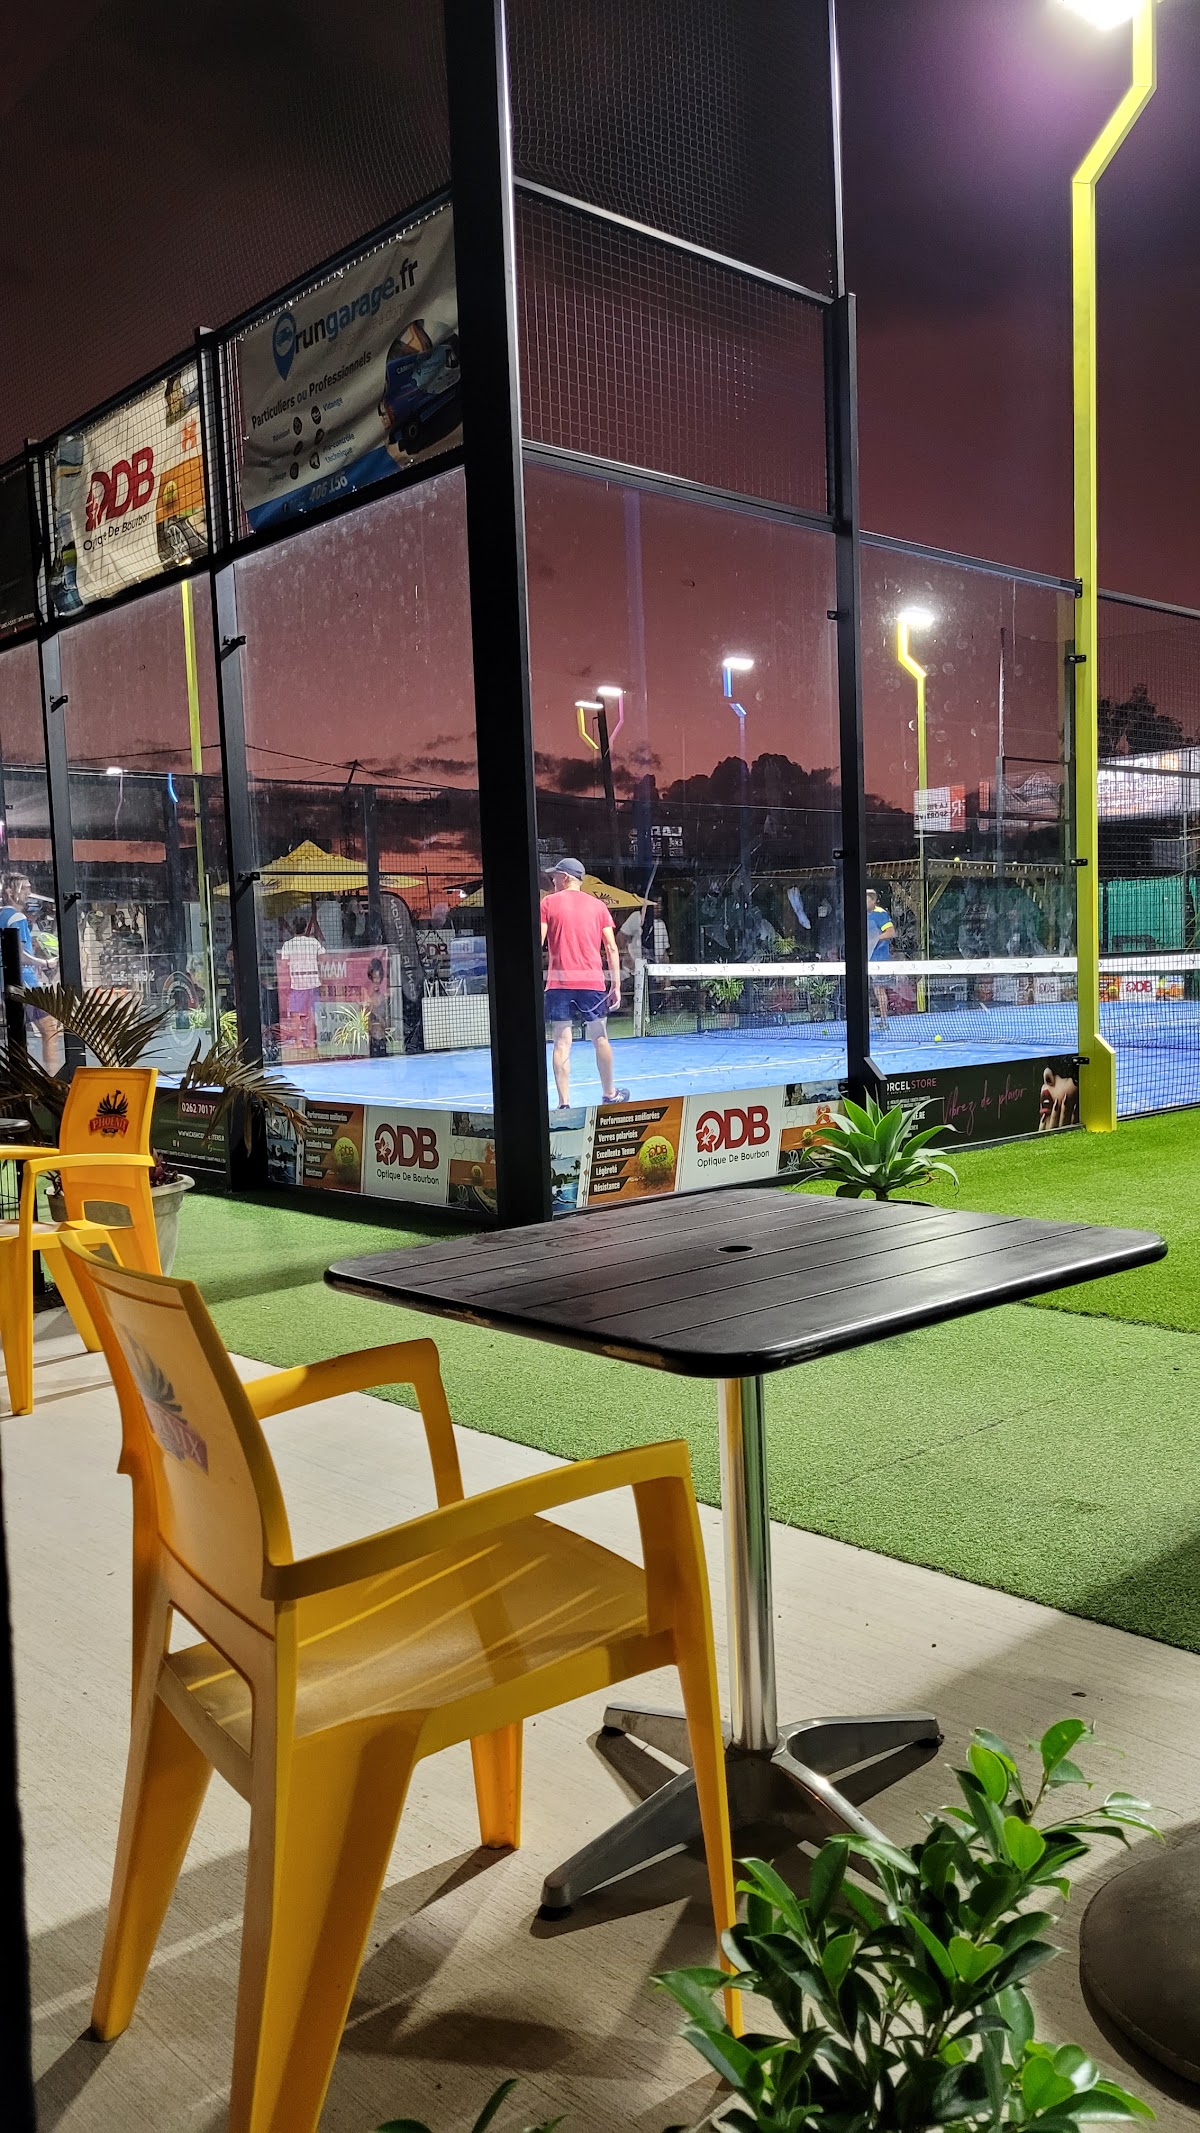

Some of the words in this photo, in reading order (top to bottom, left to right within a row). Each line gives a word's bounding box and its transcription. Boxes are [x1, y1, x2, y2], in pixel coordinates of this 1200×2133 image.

[294, 258, 418, 356] rungarage.fr
[251, 396, 295, 429] Particuliers
[297, 391, 308, 403] ou
[309, 352, 372, 397] Professionnels
[325, 447, 353, 462] technique
[309, 482, 328, 502] 406
[329, 471, 348, 494] 156
[1126, 980, 1152, 992] ODB
[911, 1077, 937, 1089] STORE
[181, 1102, 197, 1114] 0262
[198, 1104, 208, 1115] 701
[942, 1086, 977, 1136] Vibrez
[980, 1080, 992, 1108] de
[998, 1074, 1027, 1119] plaisir
[92, 1116, 127, 1131] PHOENIX
[599, 1112, 634, 1127] Performances
[634, 1110, 661, 1123] améliorées
[598, 1132, 615, 1143] Verres
[615, 1129, 639, 1142] polarisés
[696, 1105, 771, 1153] ODB
[375, 1123, 440, 1170] ODB
[596, 1148, 622, 1160] Excellente
[622, 1146, 636, 1157] Tenue
[697, 1156, 727, 1169] Optique
[728, 1154, 740, 1163] De
[741, 1149, 770, 1162] Bourbon
[376, 1168, 401, 1182] Optique
[402, 1172, 411, 1182] De
[412, 1173, 440, 1186] Bourbon
[593, 1180, 621, 1193] Résistance
